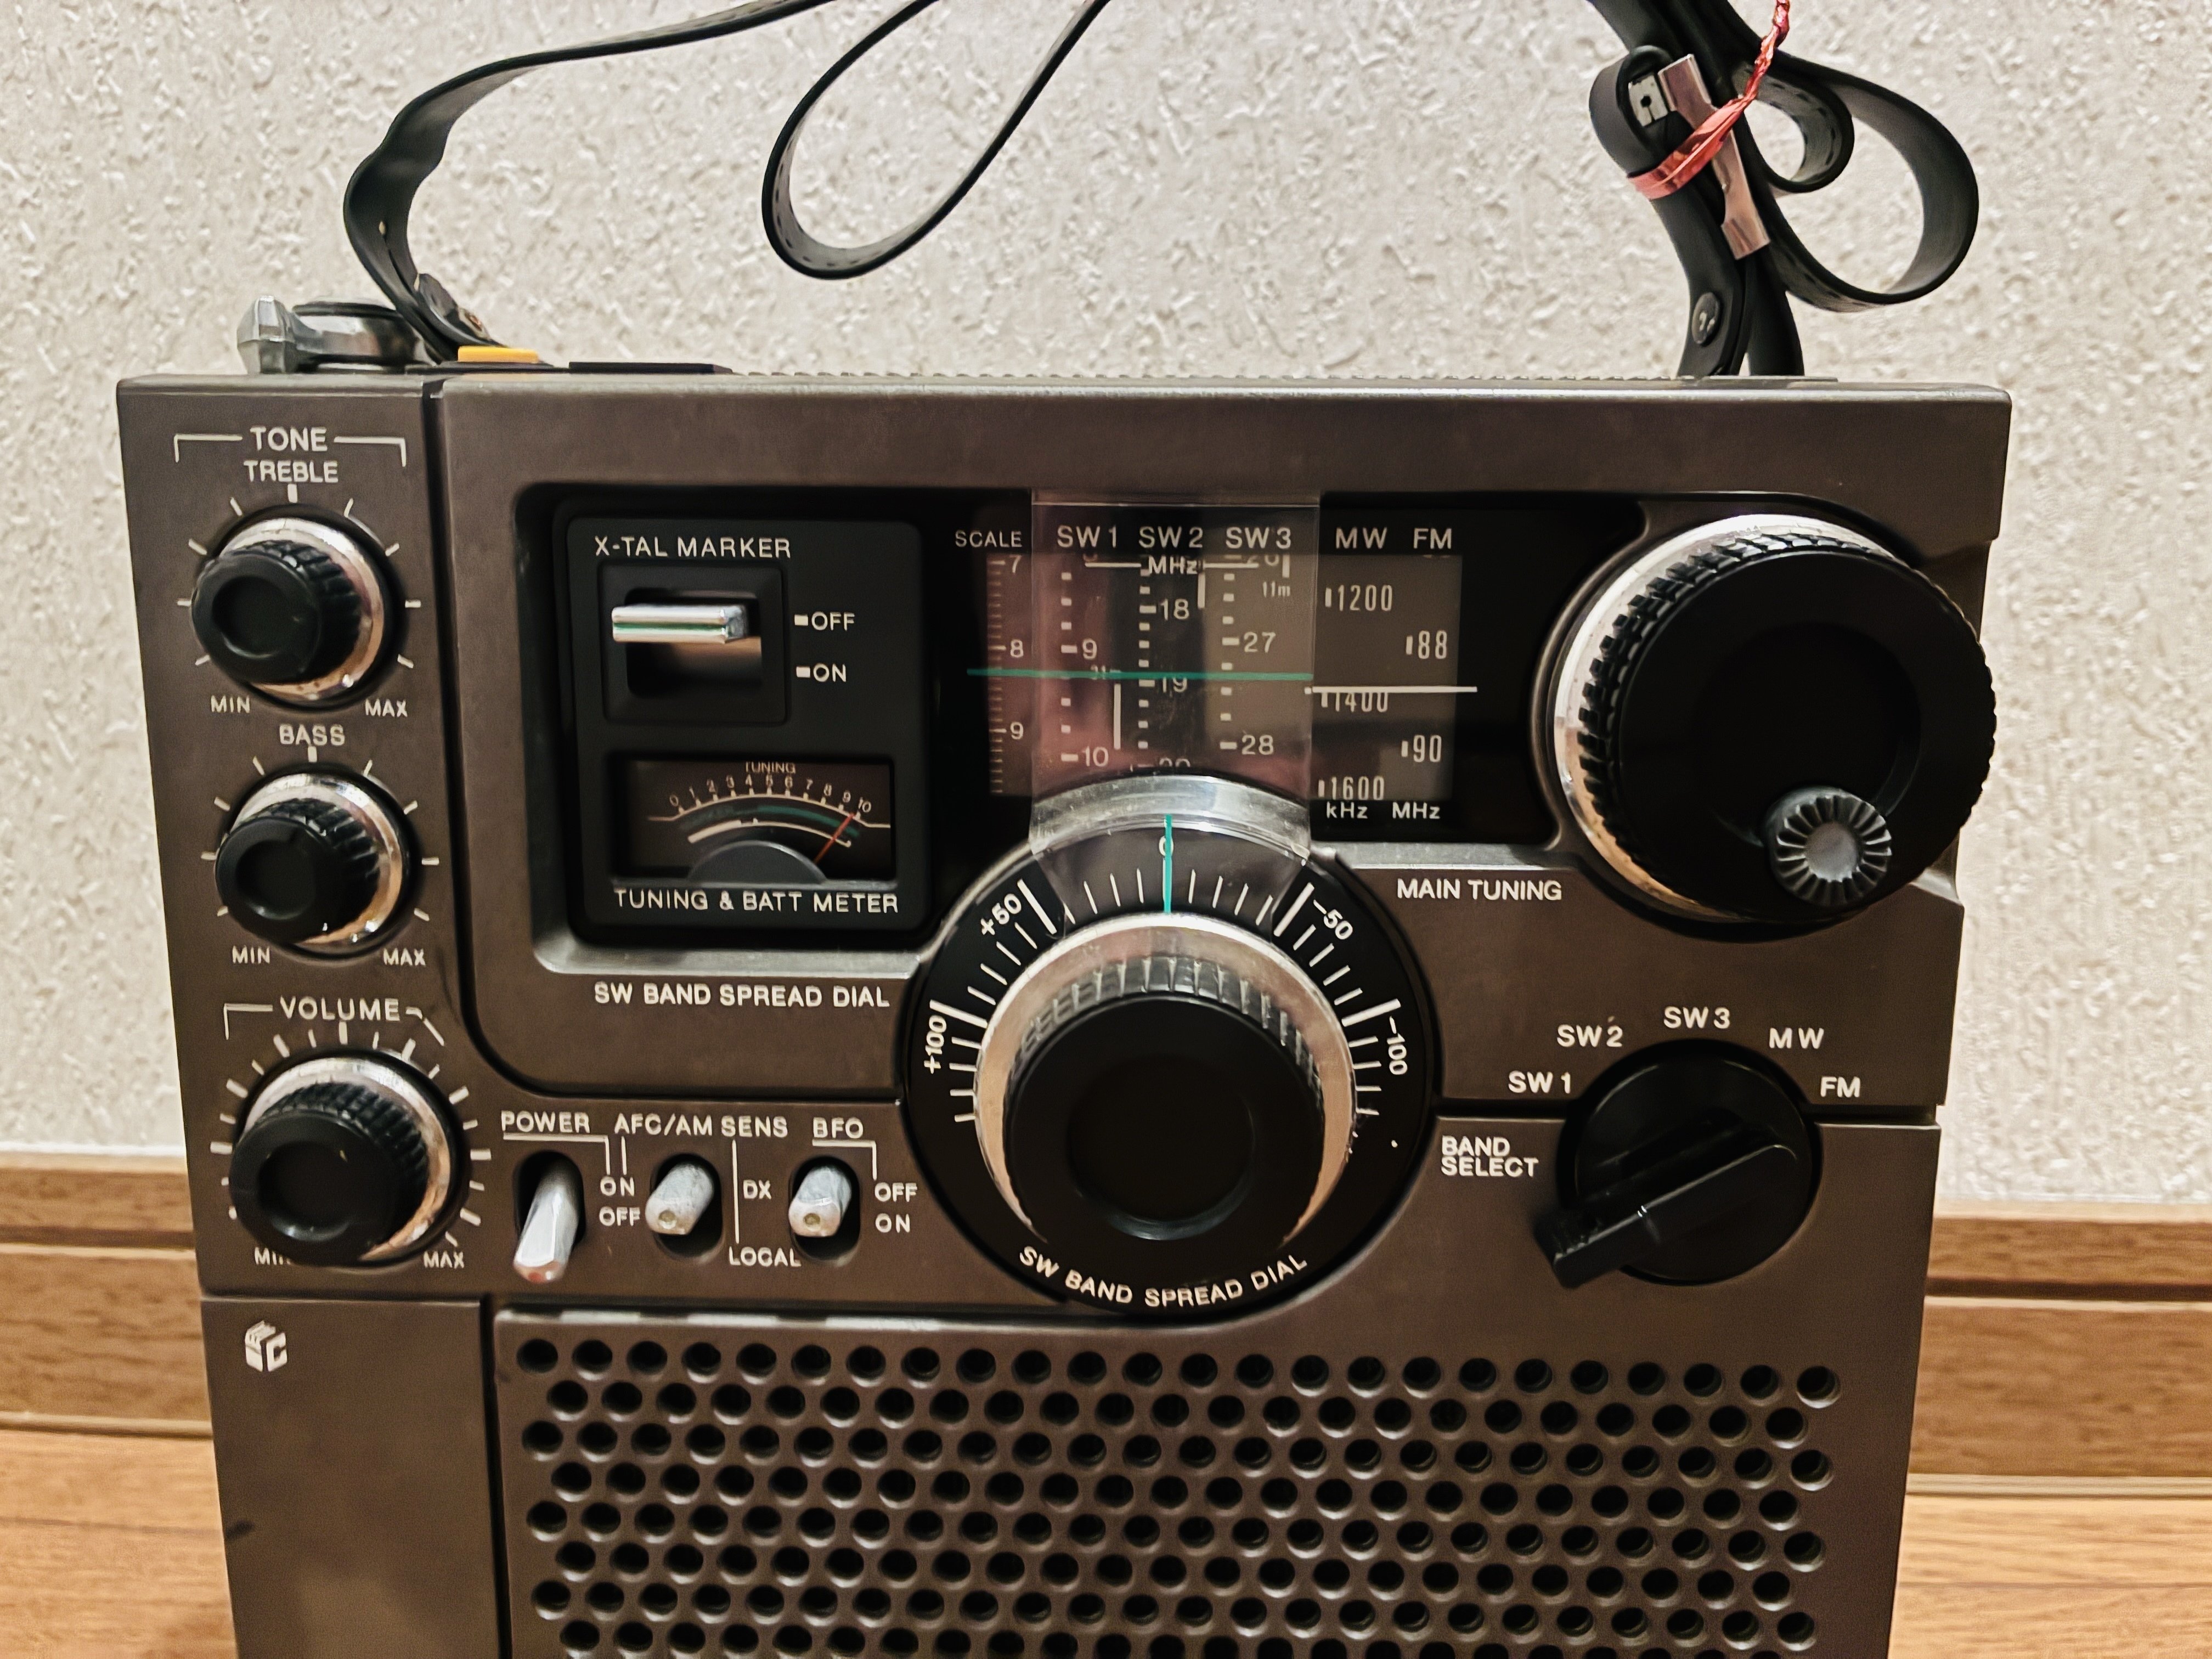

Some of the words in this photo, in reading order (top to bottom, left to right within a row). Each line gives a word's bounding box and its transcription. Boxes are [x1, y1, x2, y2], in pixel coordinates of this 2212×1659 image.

[250, 427, 328, 452] TONE
[244, 460, 338, 483] TREBLE
[595, 535, 668, 557] X-TAL
[678, 537, 791, 558] MARKER
[955, 530, 1023, 548] SCALE
[1336, 527, 1387, 549] MW
[1413, 528, 1452, 549] FM
[1009, 555, 1022, 573] 7
[1148, 555, 1197, 574] MHz
[1338, 584, 1392, 611] 1200
[1160, 598, 1189, 621] 18
[811, 611, 855, 630] OFF
[1010, 639, 1024, 658] 8
[1082, 638, 1097, 659] 9
[1243, 631, 1277, 653] 27
[1418, 630, 1447, 659] 88
[813, 663, 847, 682] ON
[211, 695, 250, 713] MIN
[365, 699, 407, 717] MAX
[280, 724, 345, 746] BASS
[1010, 721, 1024, 740] 9
[1242, 735, 1274, 755] 28
[1413, 735, 1442, 763] 90
[746, 761, 795, 774] TUNING
[1082, 746, 1109, 768] 10
[669, 794, 678, 807] 0
[689, 786, 696, 798] 1
[746, 774, 752, 786] 4
[785, 776, 793, 788] 6
[806, 778, 814, 790] 7
[824, 783, 832, 797] 8
[842, 790, 851, 803] 9
[858, 797, 871, 812] 10
[1331, 776, 1385, 800] 1600
[1327, 802, 1368, 819] kHz
[1392, 802, 1441, 819] MHz
[1397, 878, 1460, 899] MAIN
[1468, 879, 1562, 900] TUNING
[614, 887, 708, 910] TUNING
[719, 890, 734, 910] &
[743, 891, 802, 912] BATT
[814, 892, 898, 913] METER
[980, 893, 1022, 935] +50
[232, 945, 270, 964] MIN
[384, 948, 426, 966] MAX
[594, 981, 633, 1005] SW
[644, 983, 711, 1006] BAND
[720, 984, 822, 1007] SPREAD
[833, 986, 890, 1007] DIAL
[280, 996, 400, 1021] VOLUME
[924, 1015, 947, 1074] +100
[1820, 1076, 1861, 1098] FM
[501, 1110, 589, 1133] POWER
[615, 1113, 713, 1136] AFC/AM
[721, 1115, 788, 1138] SENS
[813, 1117, 864, 1138] BFO
[1442, 1135, 1510, 1156] BAND
[1441, 1157, 1538, 1177] SELECT
[600, 1176, 635, 1196] ON
[743, 1180, 771, 1200] DX
[874, 1182, 918, 1203] OFF
[599, 1207, 640, 1227] OFF
[875, 1214, 910, 1233] ON
[424, 1251, 464, 1268] MAX
[729, 1246, 802, 1267] LOCAL
[1019, 1245, 1059, 1277] SW
[1065, 1269, 1132, 1304] BAND
[1145, 1278, 1243, 1307] SPREAD
[1250, 1255, 1307, 1291] DIAL
